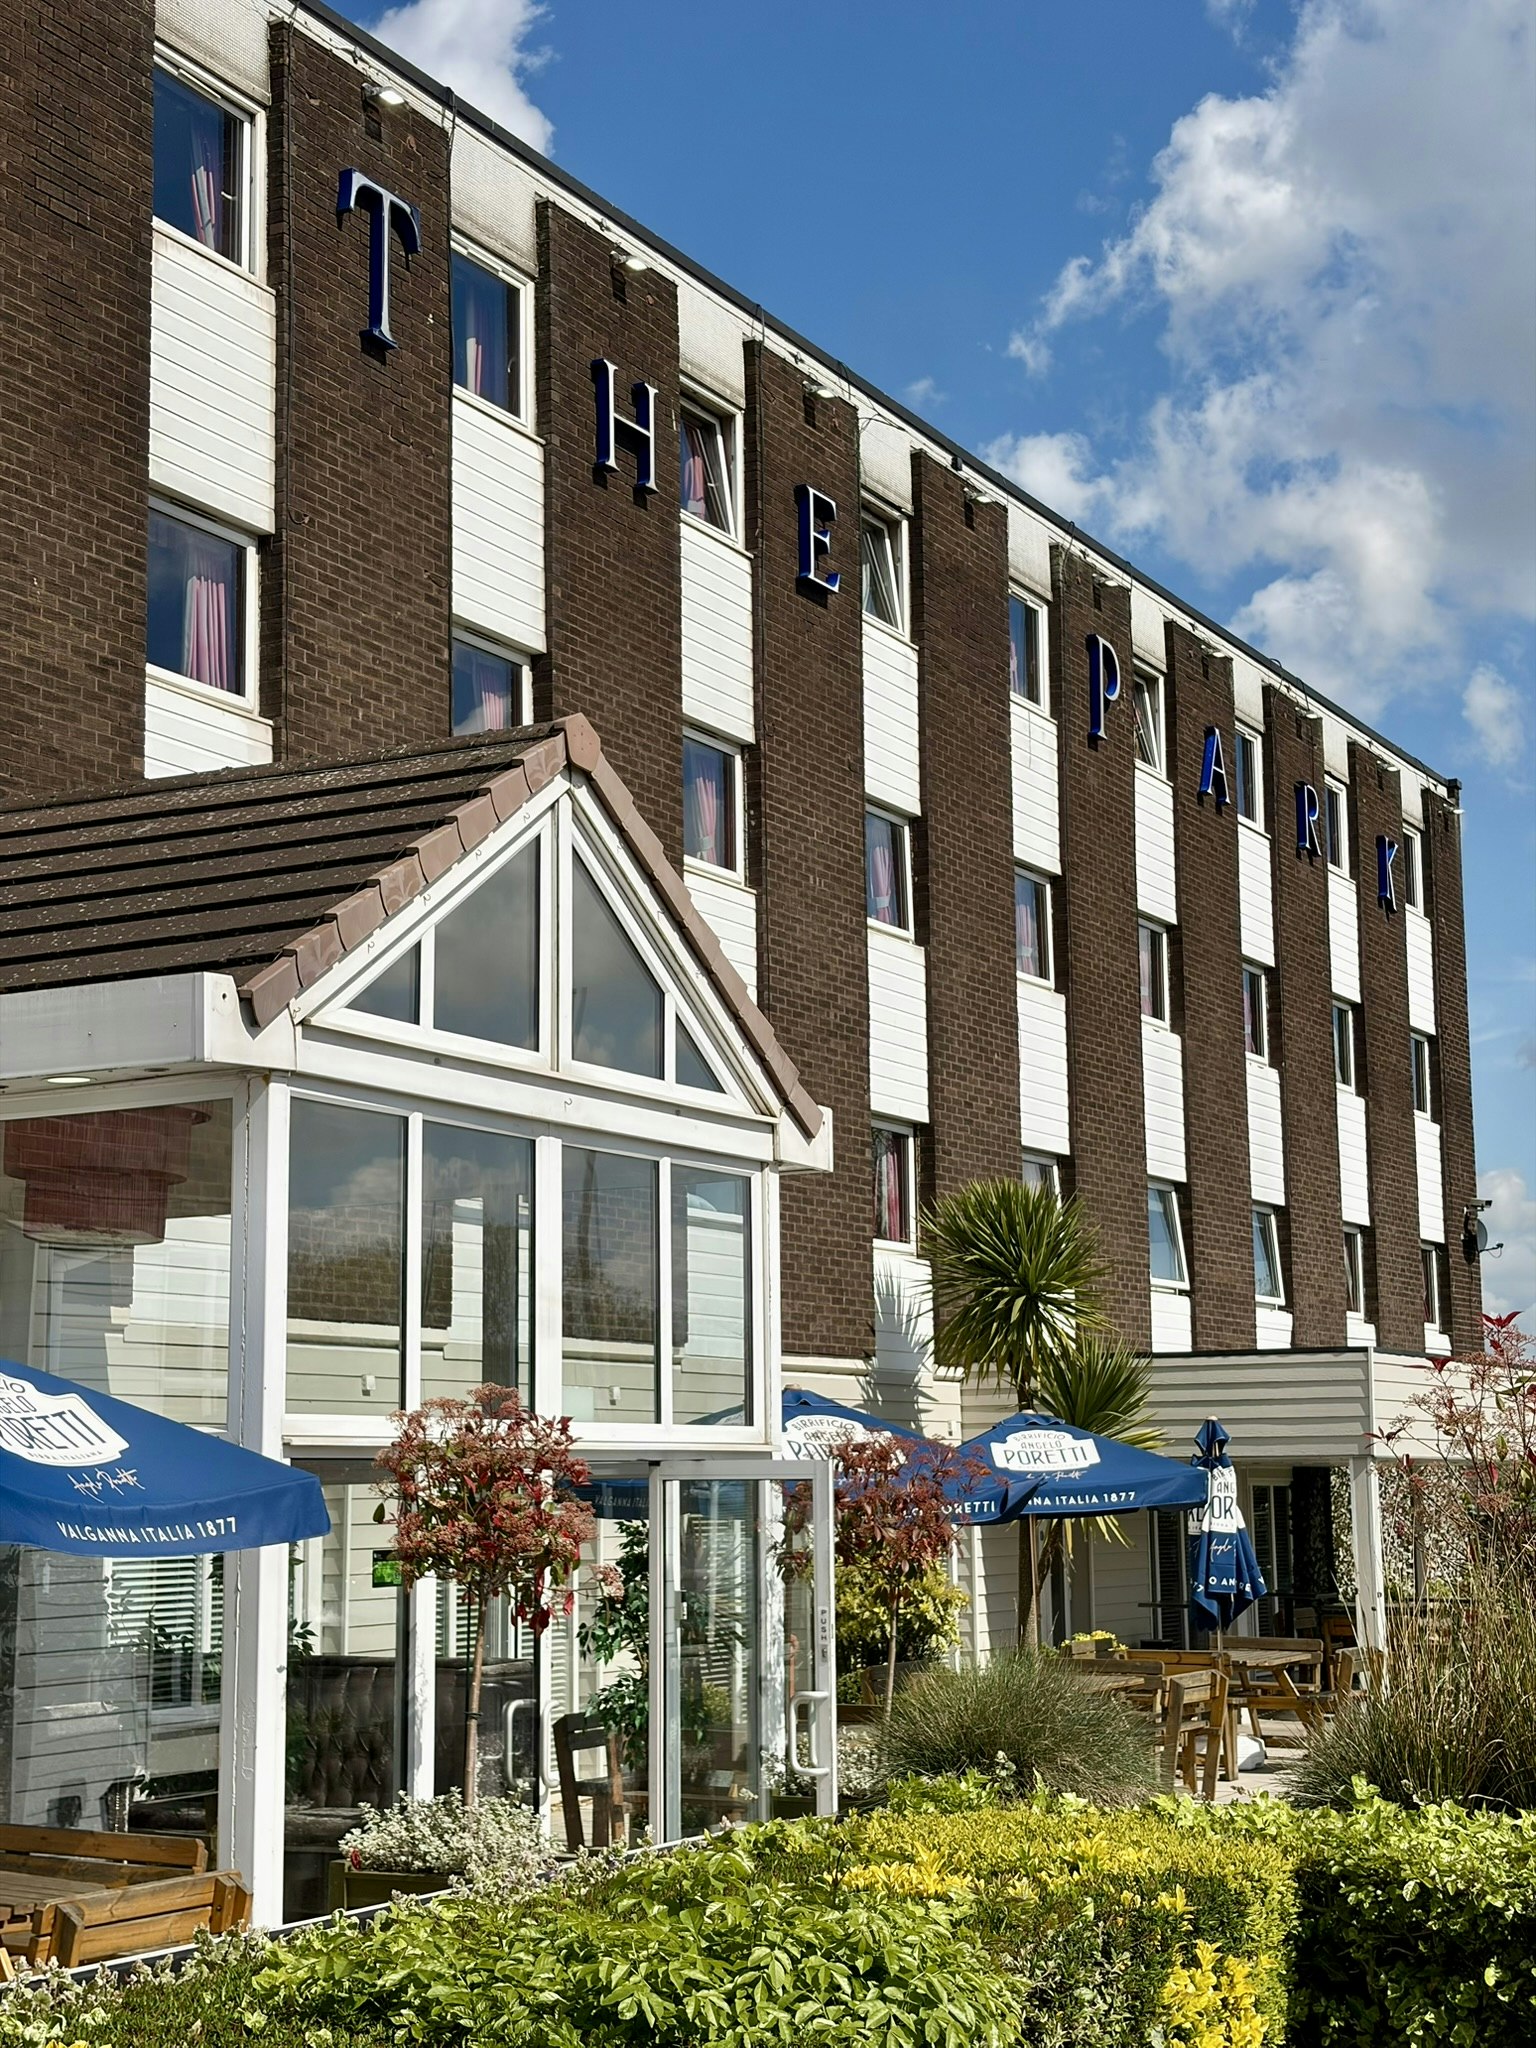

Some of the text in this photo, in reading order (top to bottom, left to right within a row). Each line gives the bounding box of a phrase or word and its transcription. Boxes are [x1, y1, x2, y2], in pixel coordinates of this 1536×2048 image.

[337, 167, 1398, 914] THE PARK
[791, 1418, 855, 1431] BIRRIFICIO
[1013, 1432, 1066, 1441] BIRRIFICIO
[1020, 1440, 1063, 1450] ANGELO
[1003, 1446, 1089, 1465] PORETTI
[1055, 1493, 1100, 1506] ITALIA
[1104, 1491, 1136, 1503] 1877
[941, 1500, 996, 1515] ORETTI
[56, 1516, 237, 1544] VALGANNA ITALIA 1877
[820, 1609, 828, 1641] PUSH
